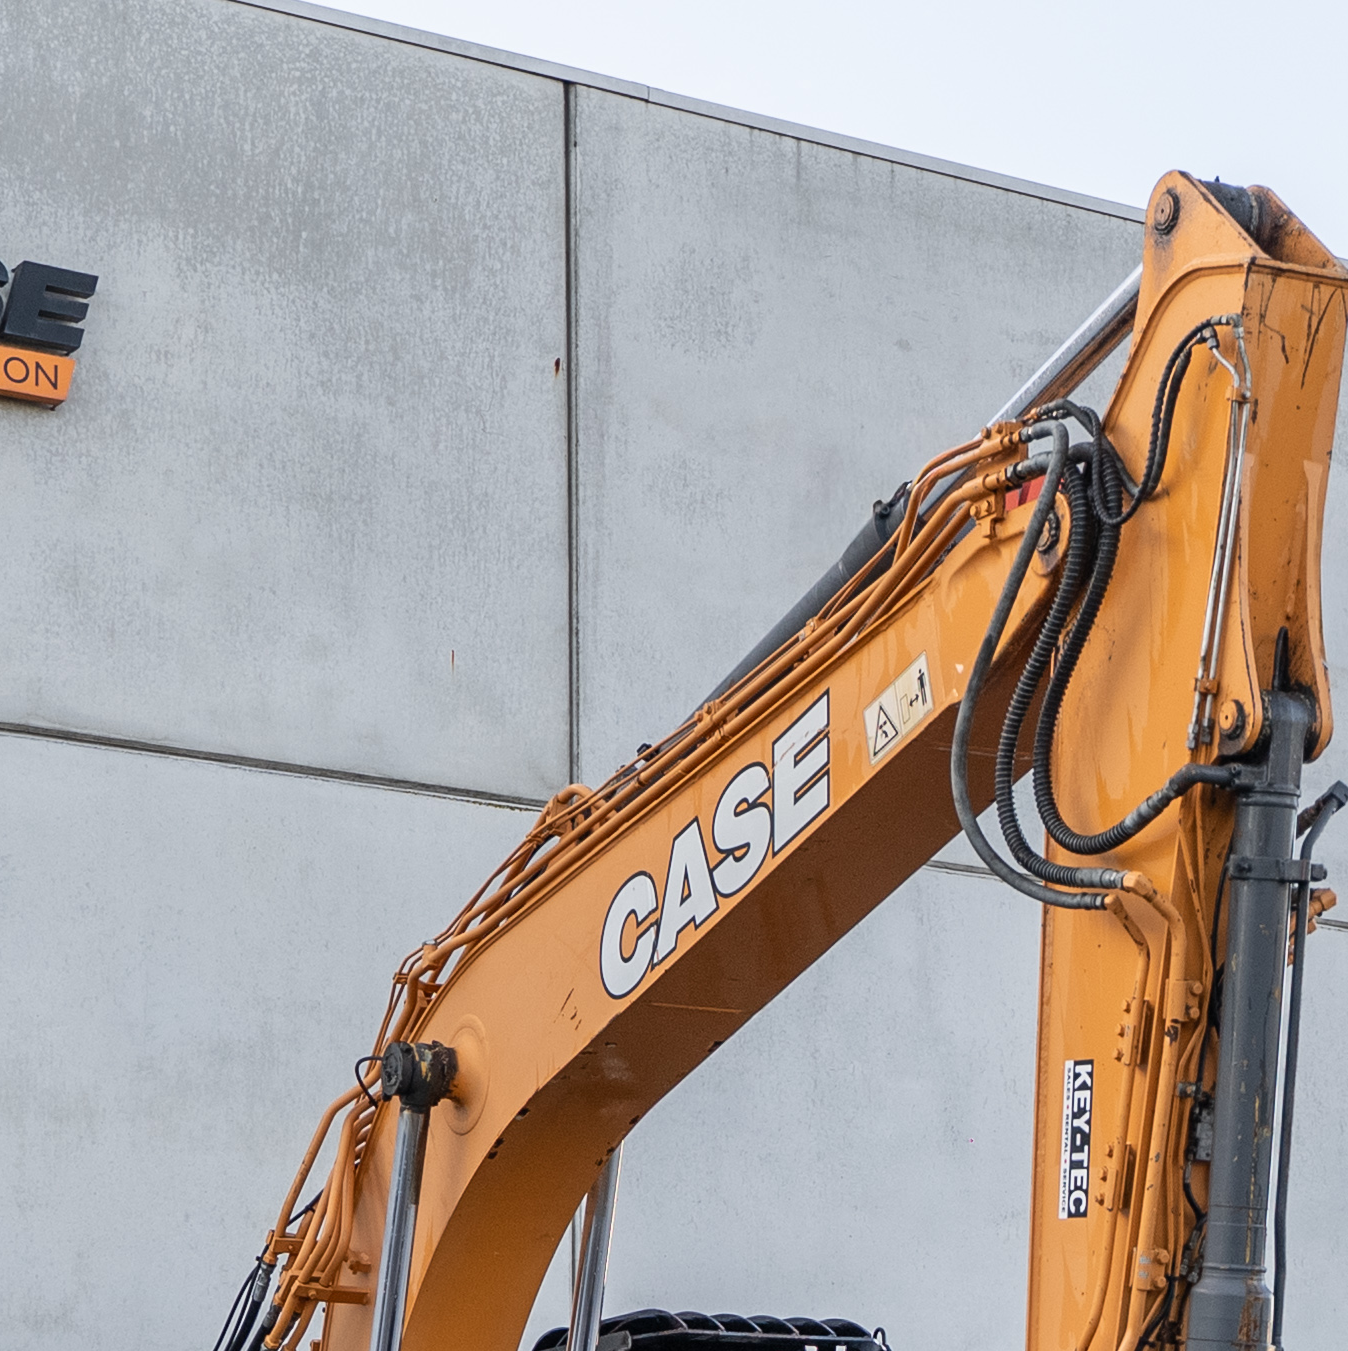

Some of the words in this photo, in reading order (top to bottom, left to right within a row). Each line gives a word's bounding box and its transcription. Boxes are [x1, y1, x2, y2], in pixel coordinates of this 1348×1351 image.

[599, 686, 831, 1000] CASE
[1060, 1168, 1068, 1213] SERVICE
[1069, 1064, 1092, 1214] KEY-TEC
